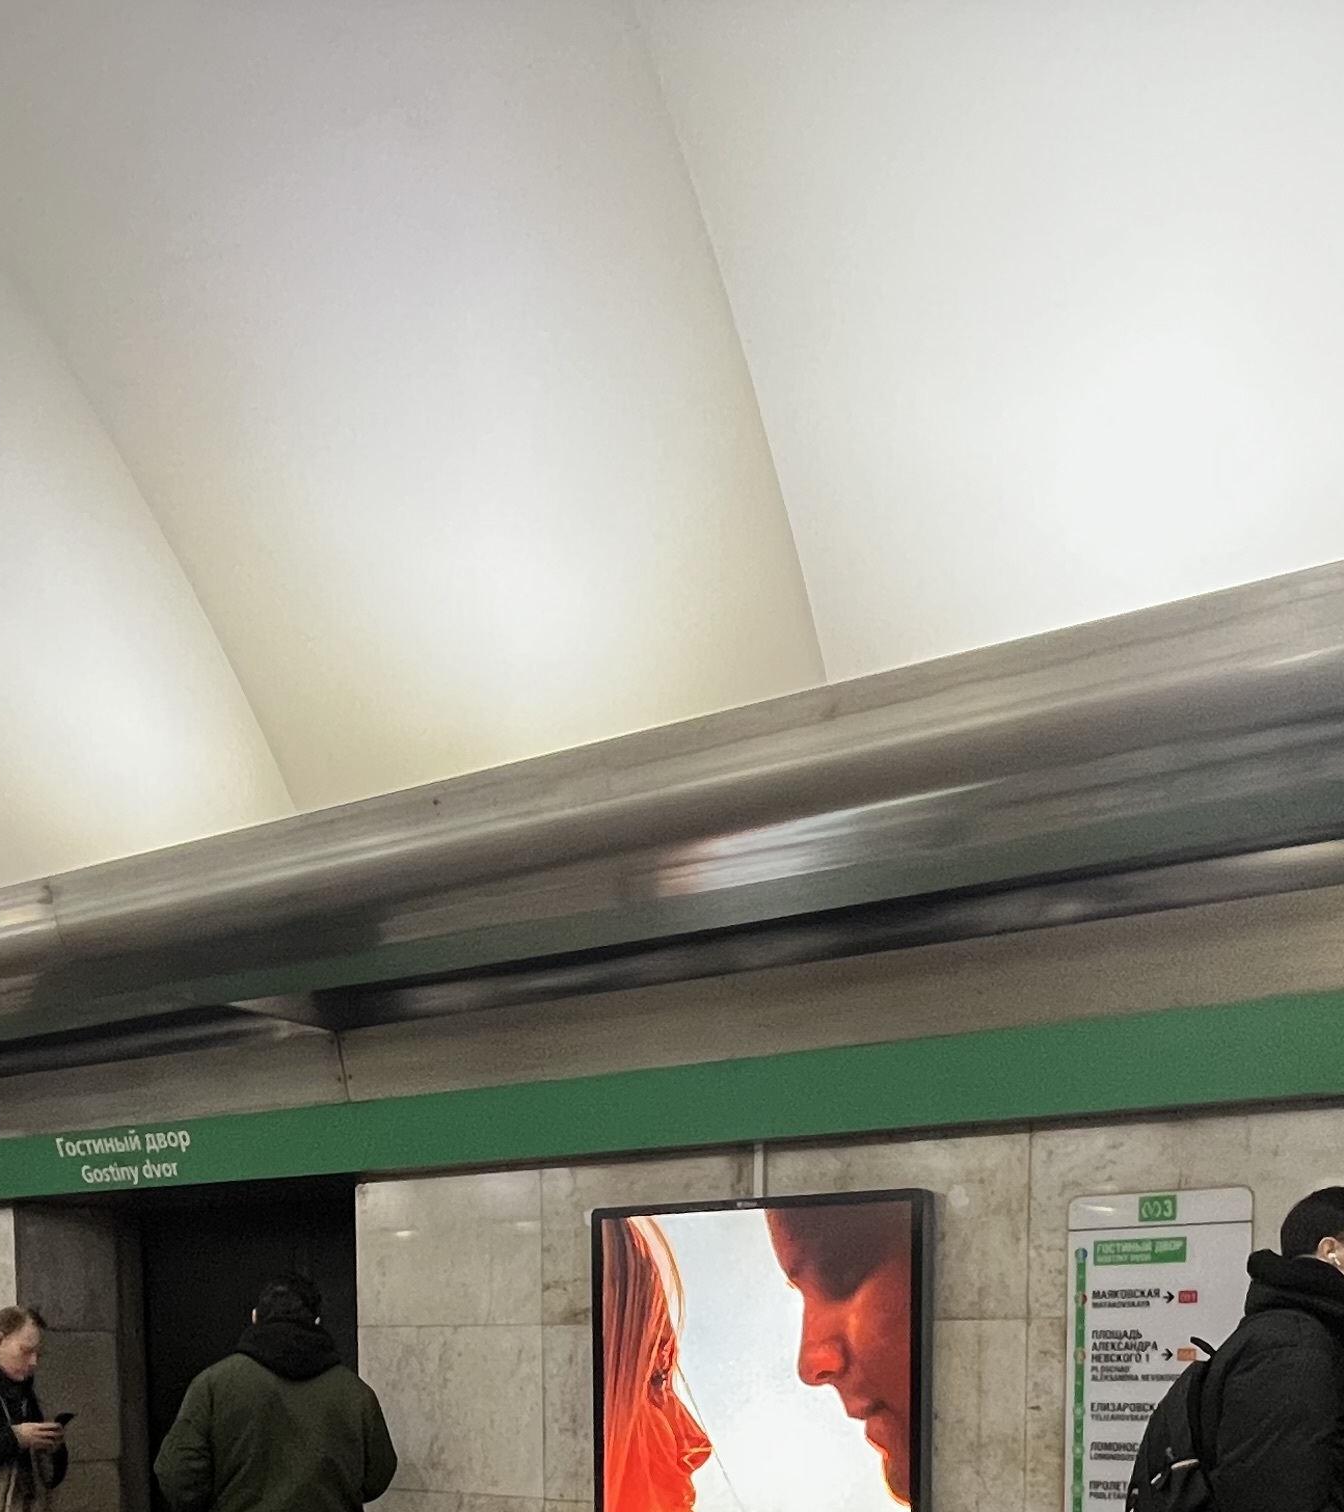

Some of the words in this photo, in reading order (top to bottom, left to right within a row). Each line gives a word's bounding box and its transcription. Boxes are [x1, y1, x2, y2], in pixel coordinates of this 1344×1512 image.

[55, 1129, 142, 1158] Гостиный
[144, 1130, 192, 1154] двор
[81, 1162, 139, 1185] Gostiny
[142, 1158, 178, 1179] dvor
[1096, 1240, 1153, 1255] ГОСТИНЫЙ
[1091, 1288, 1161, 1300] МАЯКОВСКАЯ
[1091, 1329, 1143, 1340] ПЛОЩАДЬ
[1091, 1341, 1159, 1352] АЛЕКСАНДРА
[1090, 1352, 1142, 1363] НЕВСКОГО
[1145, 1353, 1150, 1363] 1
